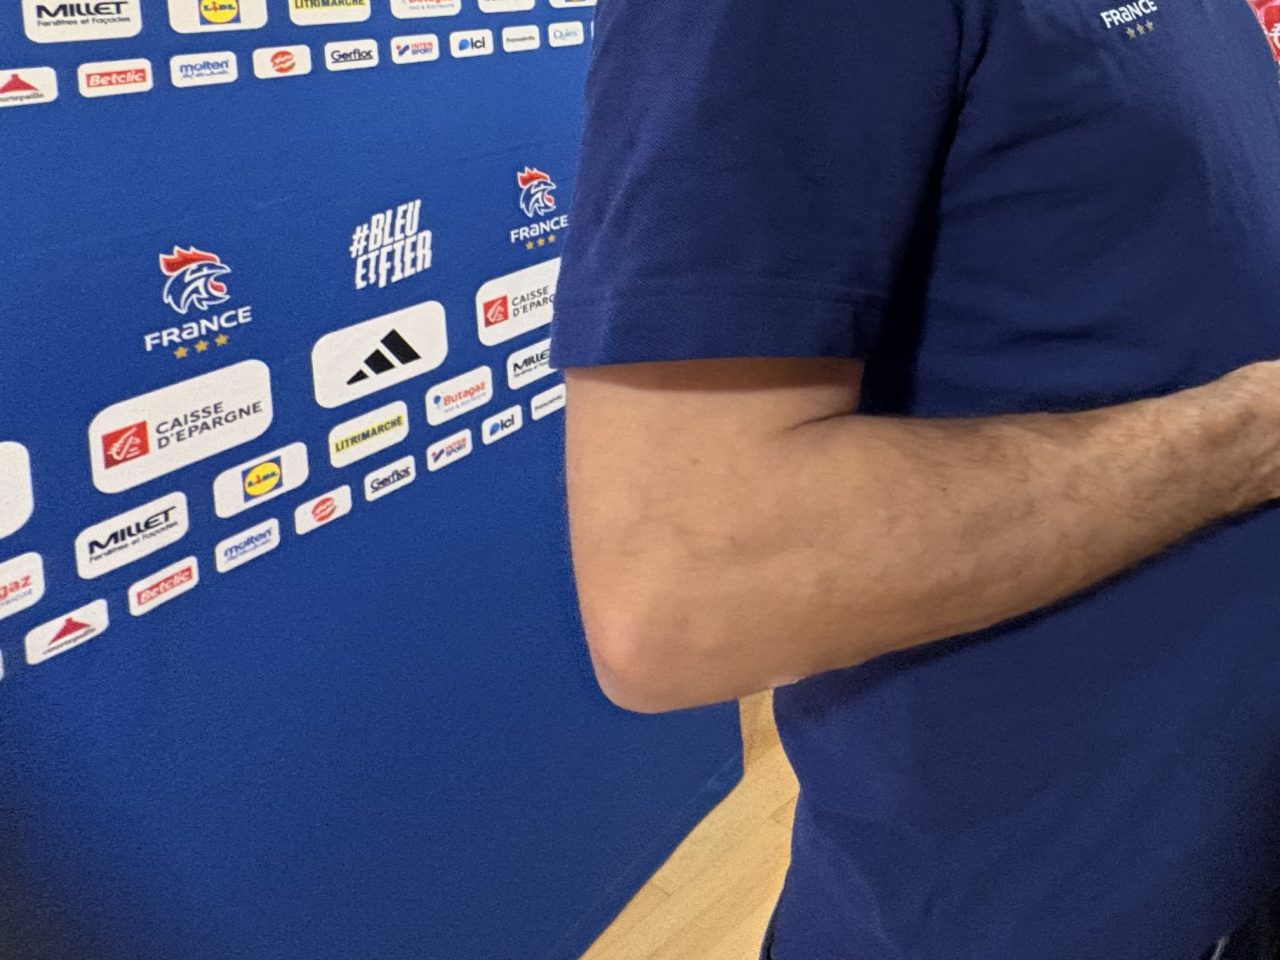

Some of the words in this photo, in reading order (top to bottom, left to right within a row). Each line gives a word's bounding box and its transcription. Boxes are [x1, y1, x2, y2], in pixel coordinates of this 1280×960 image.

[36, 1, 128, 18] MILLET
[180, 60, 229, 74] molten
[331, 49, 373, 62] Gerflor
[89, 70, 144, 86] Betclic
[349, 199, 421, 259] #BLEU
[511, 286, 549, 307] CAISSE
[513, 349, 549, 372] MILLE
[444, 382, 485, 406] Butagaz
[155, 401, 223, 434] CAISSE
[156, 401, 262, 450] D'EPARGNE
[89, 506, 176, 555] MILLET
